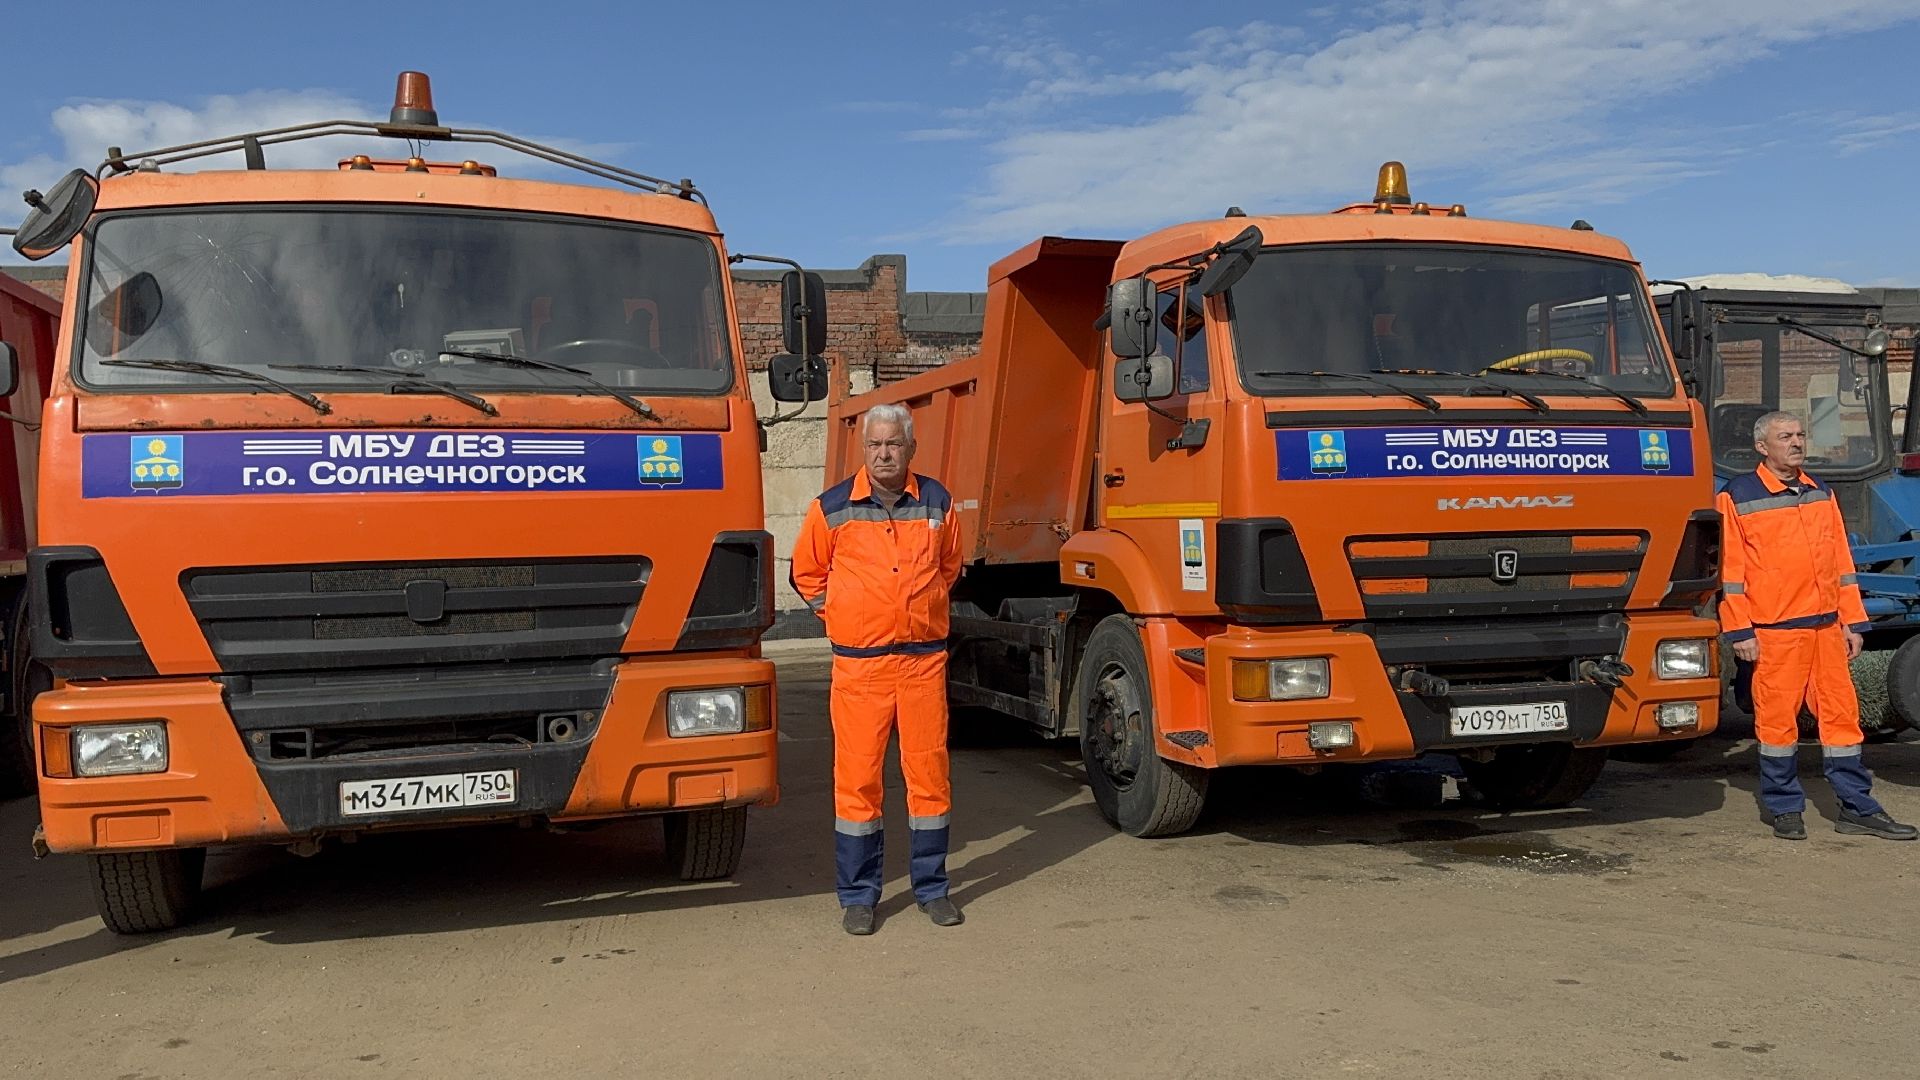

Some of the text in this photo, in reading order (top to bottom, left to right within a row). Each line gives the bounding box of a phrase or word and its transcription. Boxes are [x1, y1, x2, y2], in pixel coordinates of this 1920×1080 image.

[330, 434, 505, 458] МБУ ДЕЗ
[1443, 429, 1558, 448] МБУ ДЕЗ
[1387, 450, 1610, 472] г.о. Солнечногорск
[243, 461, 586, 488] г.о. Солнечногорск
[1438, 495, 1574, 511] KAMAZ
[1534, 705, 1561, 721] 750
[1541, 720, 1554, 728] RUS
[466, 773, 507, 794] 750
[476, 793, 496, 801] RUS
